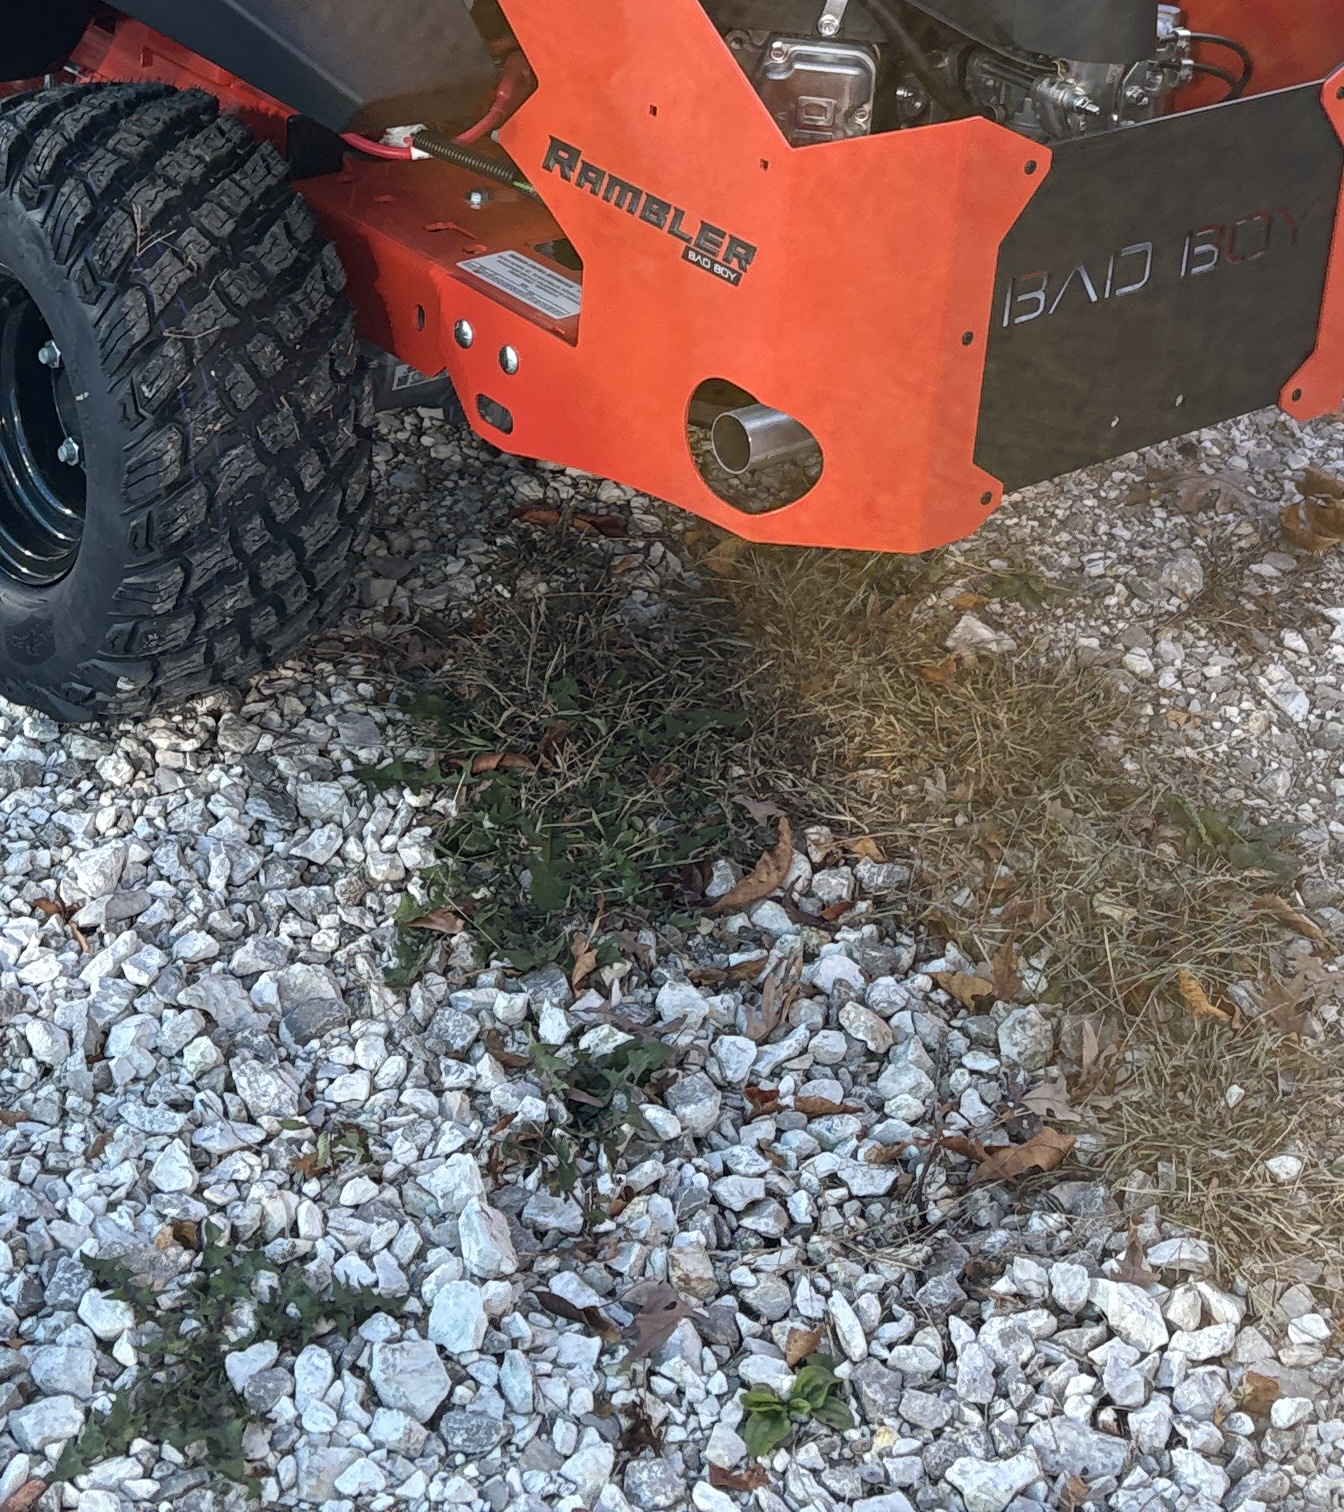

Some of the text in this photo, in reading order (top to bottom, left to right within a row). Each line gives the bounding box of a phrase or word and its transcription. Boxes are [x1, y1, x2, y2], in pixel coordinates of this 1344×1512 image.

[542, 135, 758, 274] RAMBLER
[687, 249, 738, 283] BAD BOY
[1001, 201, 1312, 329] BAD BOY
